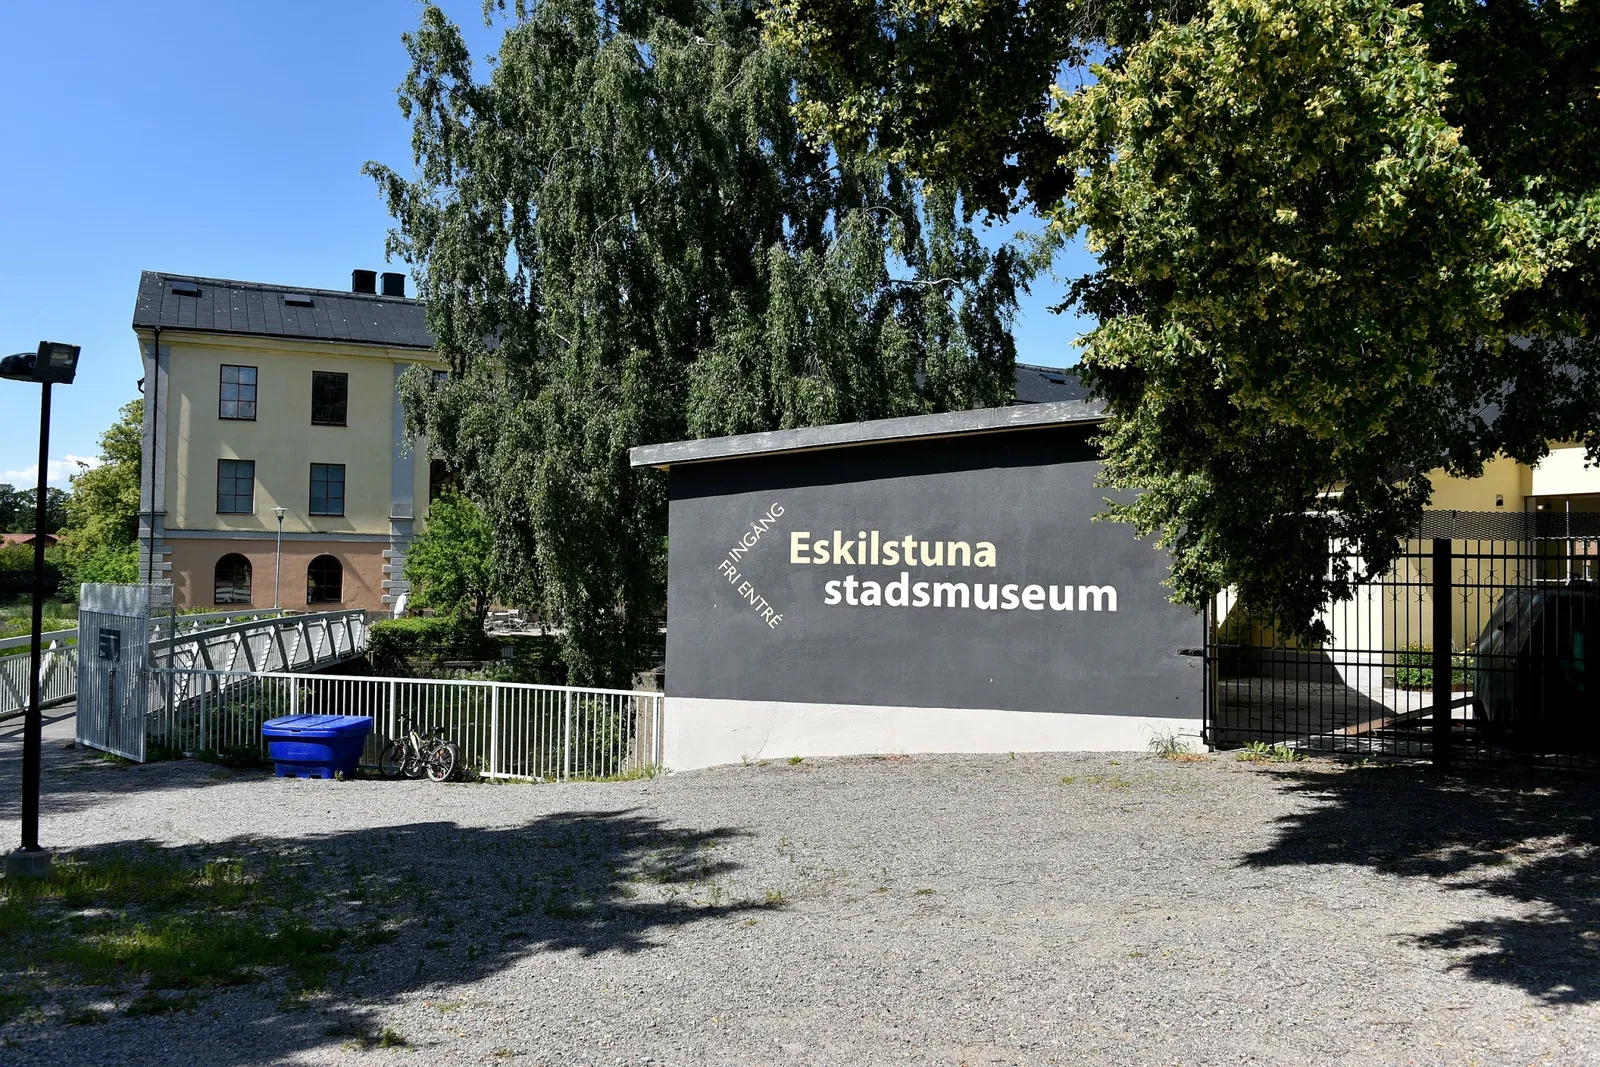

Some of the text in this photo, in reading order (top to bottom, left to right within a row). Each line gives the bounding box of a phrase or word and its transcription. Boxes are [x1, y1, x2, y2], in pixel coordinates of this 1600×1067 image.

[728, 502, 785, 563] INGÅNG
[790, 530, 996, 568] Eskilstuna
[717, 559, 784, 630] FRI ENTRÉ
[824, 572, 1118, 612] stadsmuseum
